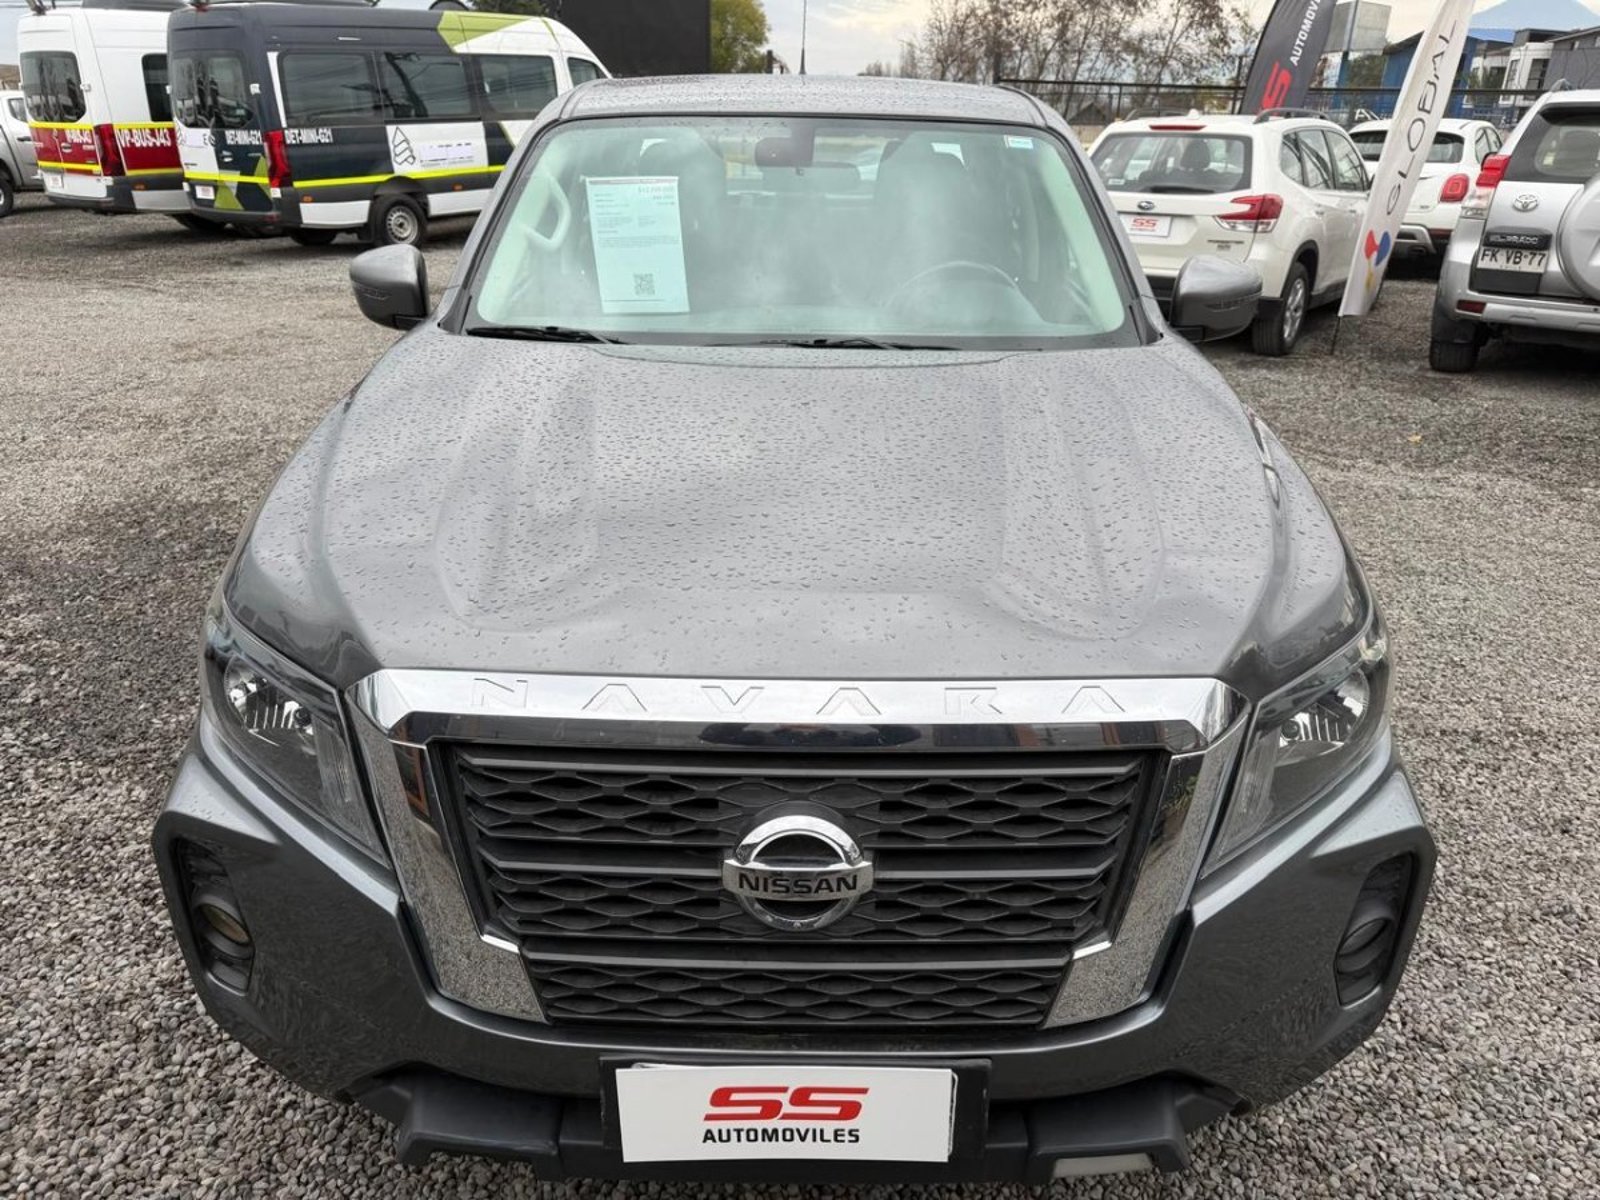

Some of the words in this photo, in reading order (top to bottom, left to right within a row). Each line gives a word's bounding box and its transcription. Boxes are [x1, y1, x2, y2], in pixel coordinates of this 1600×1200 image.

[1289, 0, 1321, 66] AUTOMOV
[1386, 20, 1457, 215] GLOBAL
[1481, 249, 1500, 262] FK
[1505, 250, 1523, 265] VB
[1528, 252, 1546, 267] 77
[472, 677, 1126, 716] NAVARA
[738, 872, 857, 895] NISSAN
[703, 1086, 870, 1122] SS
[702, 1127, 861, 1144] AUTOMOVILES
